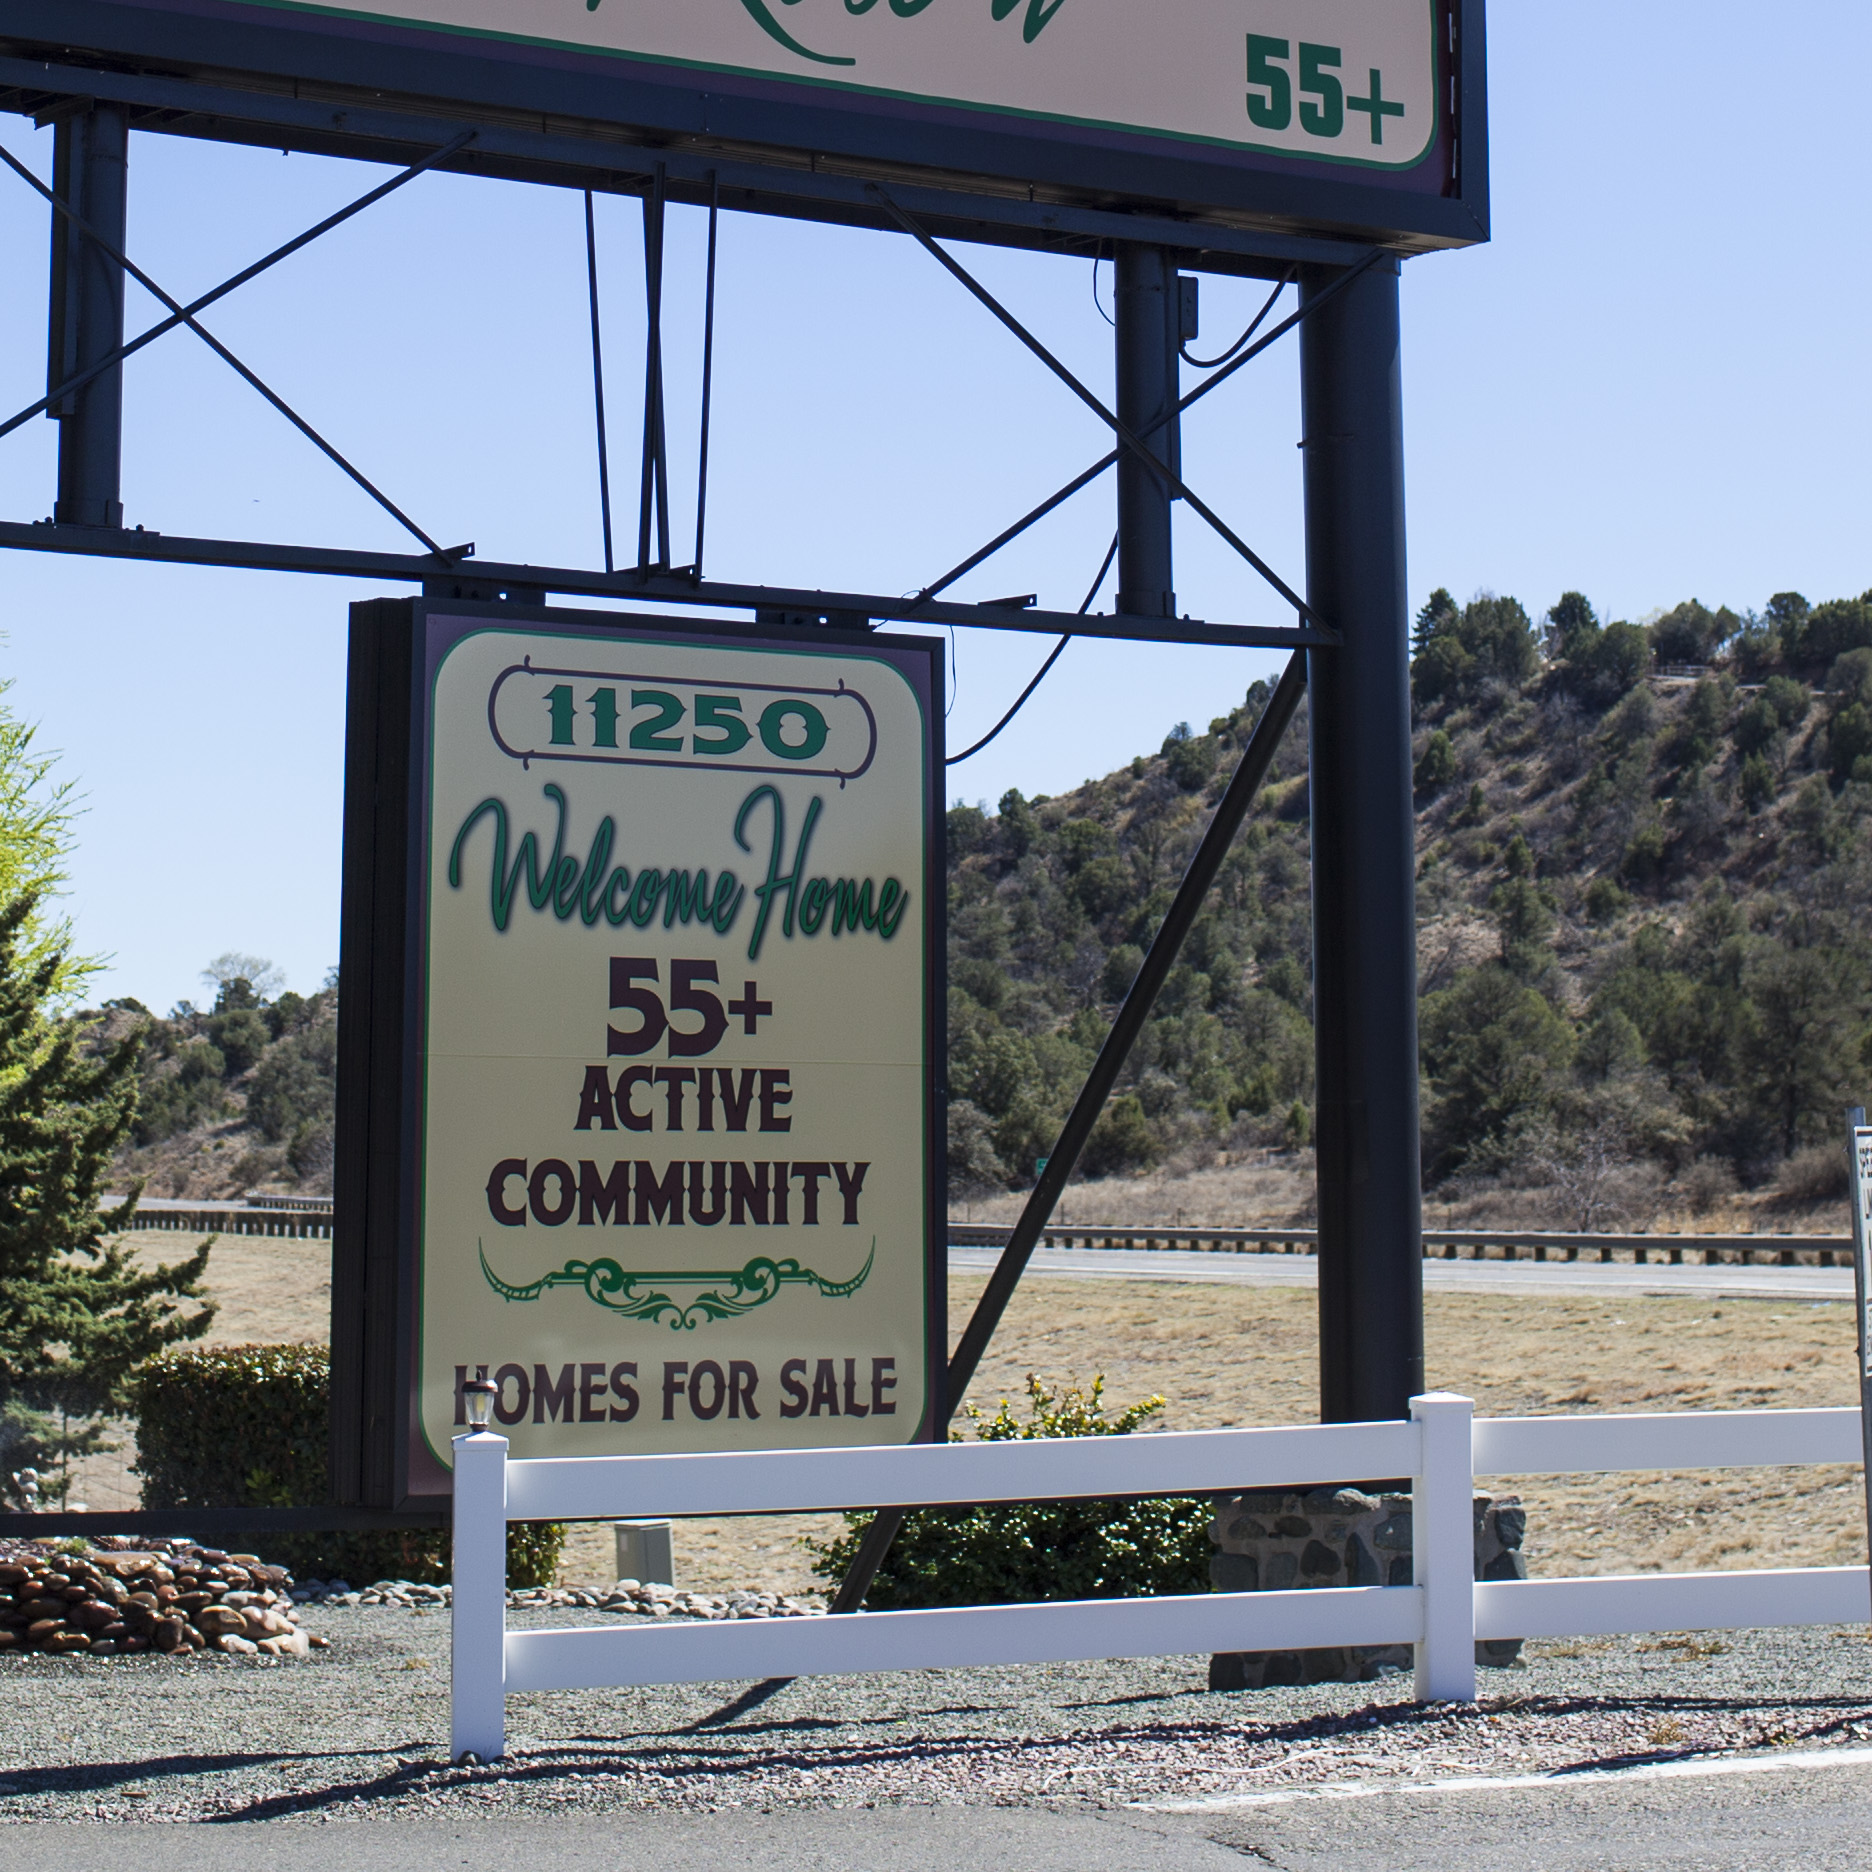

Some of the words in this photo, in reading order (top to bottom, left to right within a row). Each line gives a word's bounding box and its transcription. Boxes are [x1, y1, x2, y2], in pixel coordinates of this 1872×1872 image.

[1244, 33, 1406, 145] 55+
[543, 685, 831, 760] 11250
[449, 783, 741, 934] Welcome
[734, 784, 911, 960] Home
[606, 956, 773, 1062] 55+
[573, 1064, 793, 1134] ACTIVE
[485, 1158, 871, 1228] COMMUNITY
[661, 1360, 761, 1421] FOR
[779, 1358, 898, 1419] SALE
